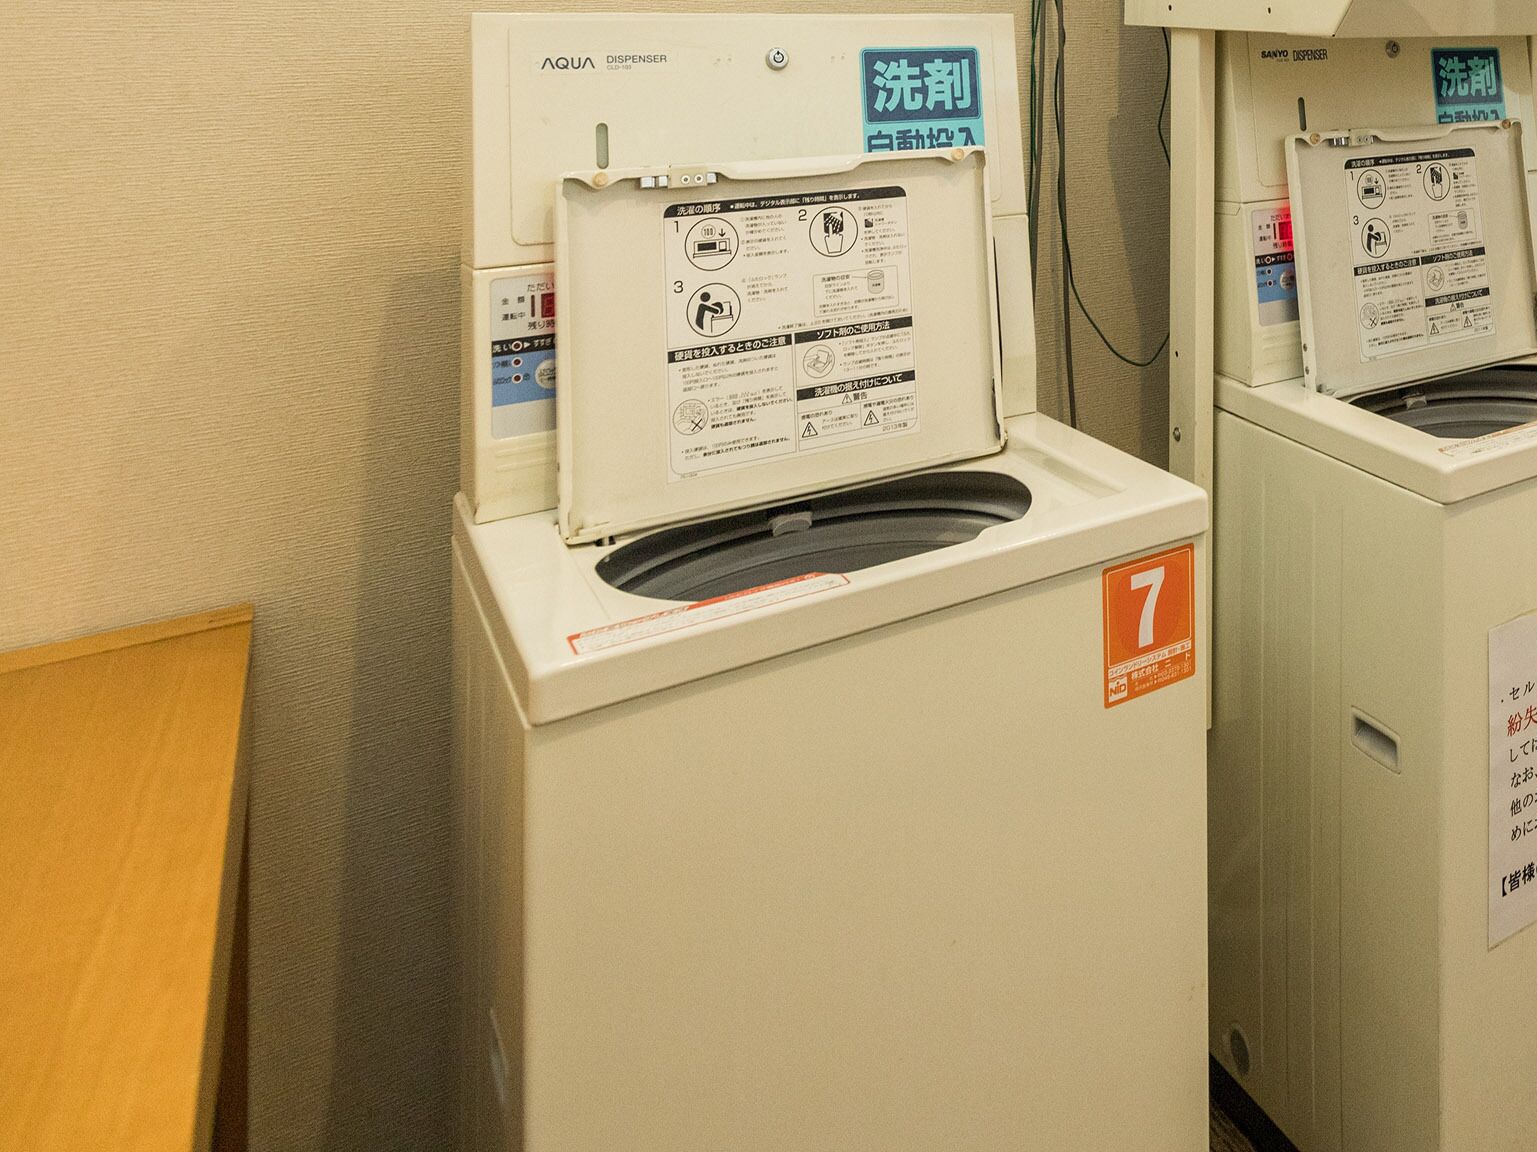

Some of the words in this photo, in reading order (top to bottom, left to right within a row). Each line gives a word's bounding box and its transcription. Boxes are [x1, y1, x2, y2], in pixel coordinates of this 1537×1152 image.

[541, 56, 595, 70] AQUA
[606, 54, 667, 64] DISPENSER
[1261, 49, 1289, 59] SANYO
[1292, 49, 1328, 61] DISPENSER
[1438, 56, 1497, 97] 洗剤
[873, 58, 972, 113] 洗剤
[1416, 164, 1422, 174] 2
[677, 204, 721, 216] 洗濯の順序
[798, 209, 807, 221] 2
[673, 220, 679, 233] 1
[1352, 215, 1359, 225] 3
[673, 280, 684, 294] 3
[817, 321, 890, 339] ソフト剤のご使用方法
[674, 336, 787, 362] 硬貨を投入するときのご注意
[814, 373, 903, 397] 洗濯機の据え付けについて
[852, 392, 868, 401] 警告
[1130, 565, 1165, 648] 7
